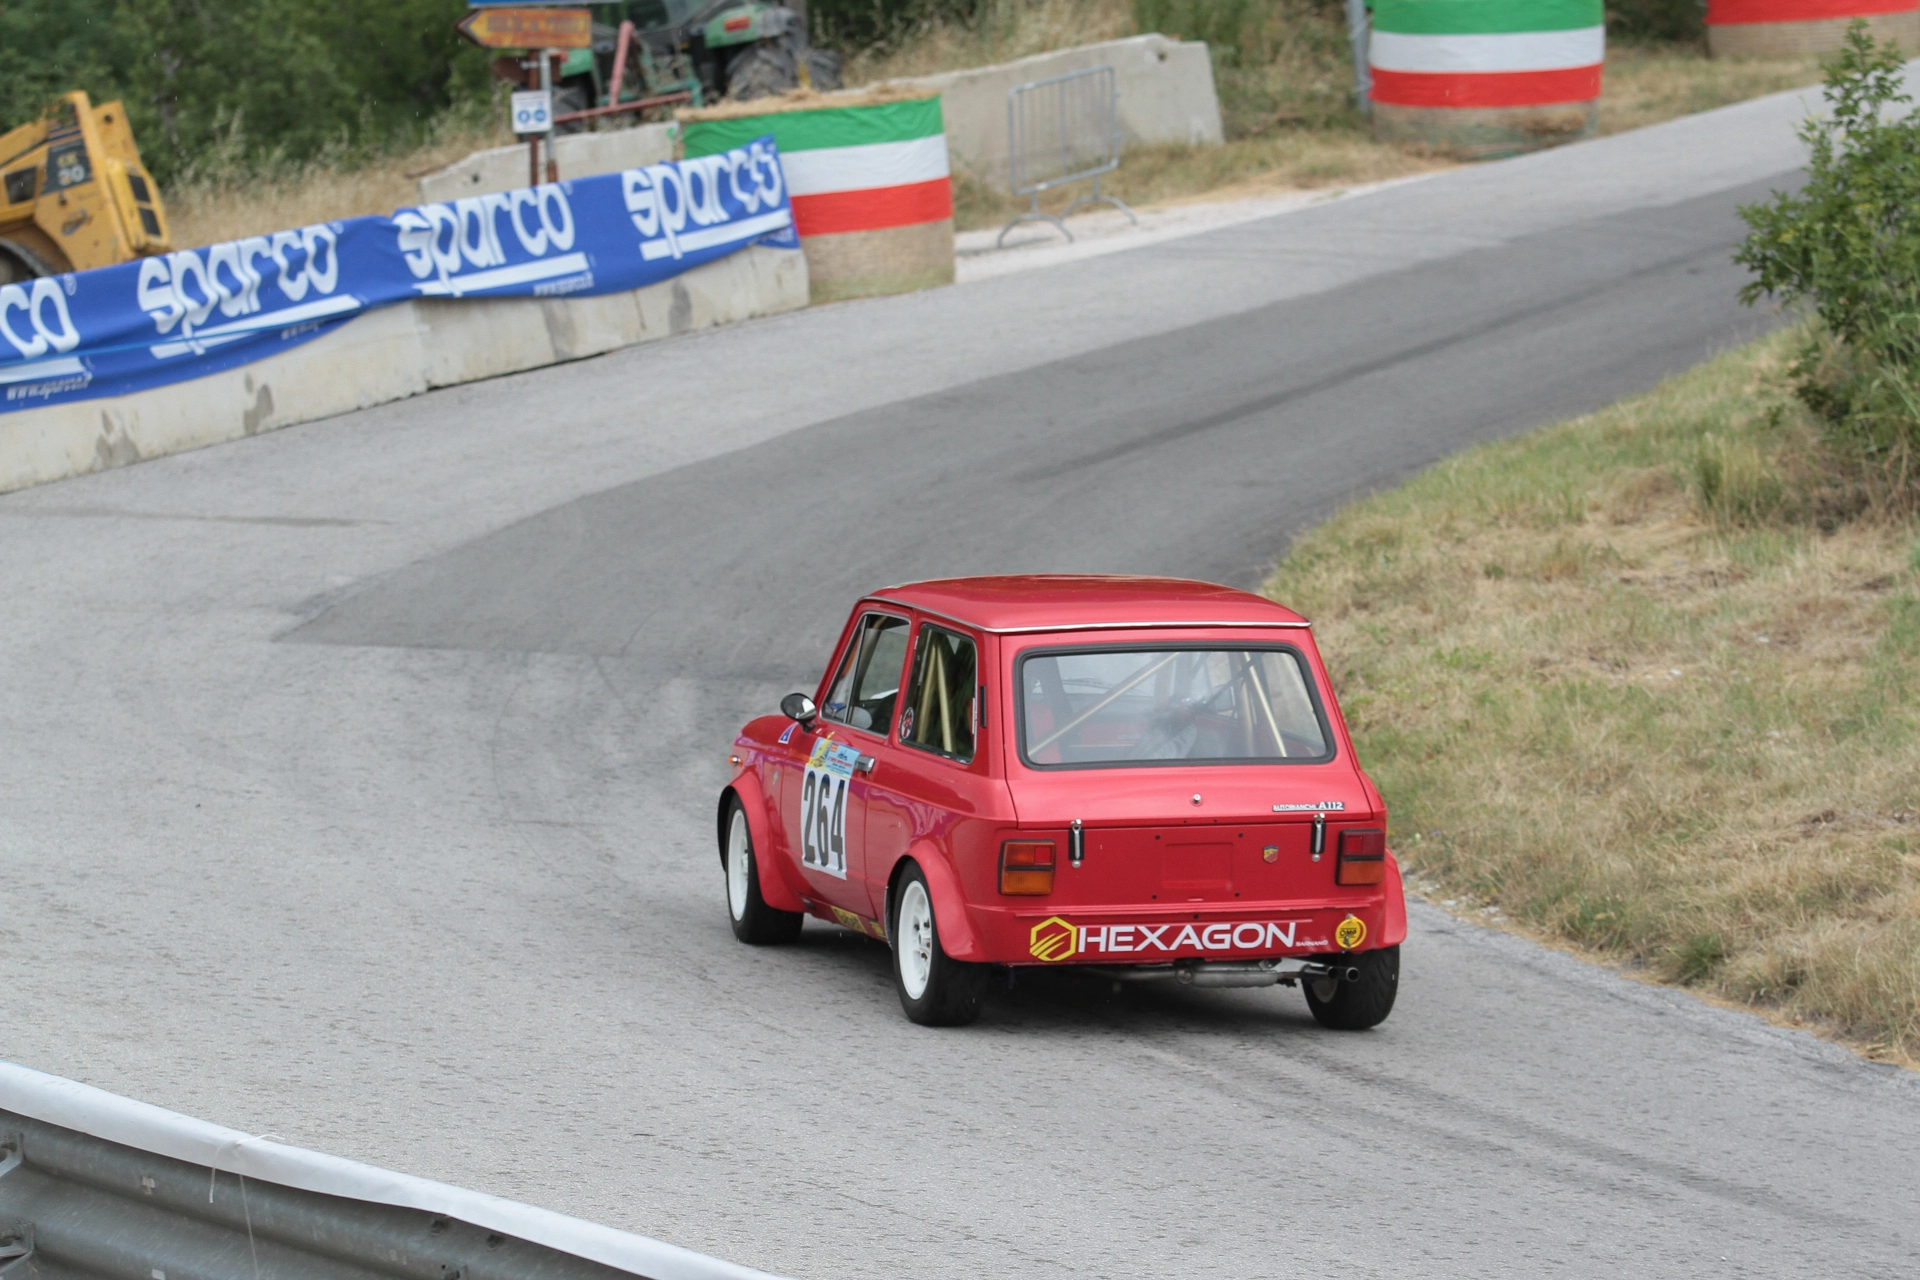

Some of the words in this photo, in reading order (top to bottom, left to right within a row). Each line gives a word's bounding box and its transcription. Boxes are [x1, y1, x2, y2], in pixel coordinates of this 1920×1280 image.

[392, 182, 576, 298] sparco
[621, 142, 783, 260] sparco
[137, 223, 338, 356] sparco
[802, 770, 846, 872] 264
[1318, 801, 1344, 811] A112
[1077, 922, 1297, 953] HEXAGON
